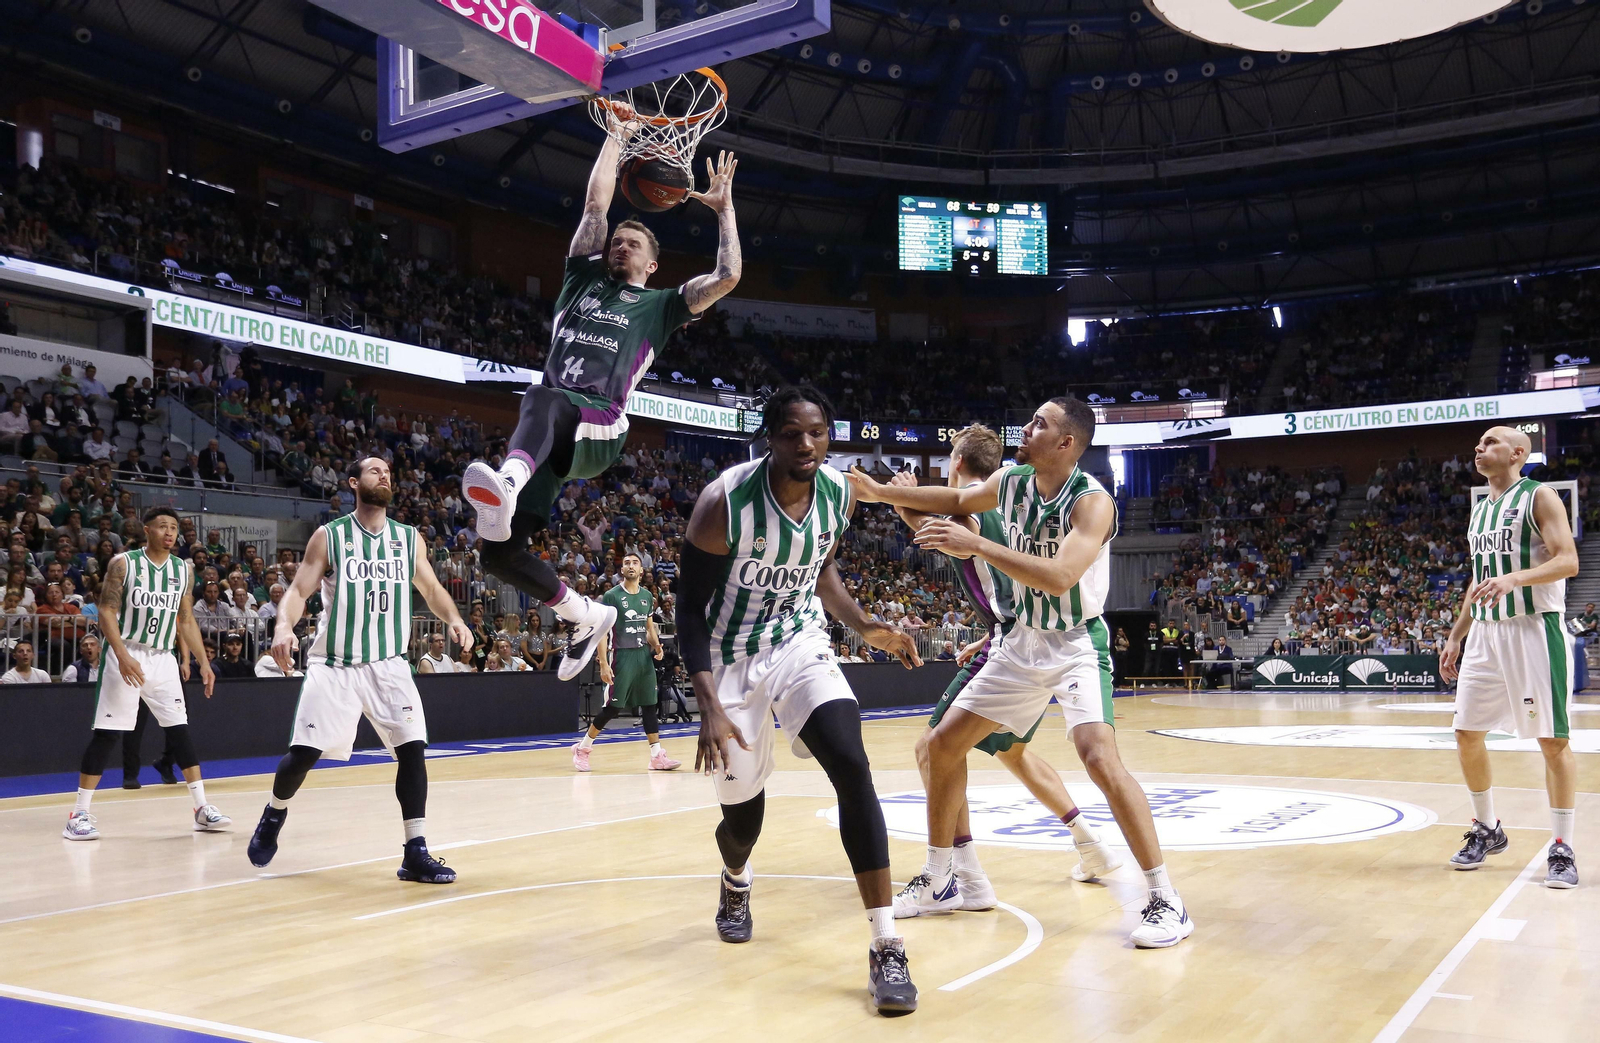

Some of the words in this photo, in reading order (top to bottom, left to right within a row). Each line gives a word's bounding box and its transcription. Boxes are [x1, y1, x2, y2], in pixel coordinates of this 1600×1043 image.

[946, 201, 960, 212] 68
[986, 203, 1000, 214] 59
[963, 250, 971, 261] 5
[982, 251, 990, 261] 5
[156, 296, 274, 342] CÉNT/LITRO
[280, 326, 305, 349] EN
[310, 332, 360, 360] CADA
[364, 344, 389, 365] REI
[577, 331, 618, 350] MÁLAGA
[41, 351, 54, 361] de
[56, 354, 94, 370] Málaga
[561, 355, 585, 382] 14
[667, 402, 683, 419] EN
[685, 406, 717, 426] CADA
[1284, 413, 1297, 435] 3
[1303, 410, 1393, 431] CÉNT/LITRO
[1397, 408, 1418, 423] EN
[1424, 404, 1469, 421] CADA
[1474, 401, 1499, 417] REI
[861, 425, 879, 440] 68
[240, 526, 269, 538] Málaga
[367, 590, 389, 613] 10
[762, 596, 797, 624] 15
[147, 617, 159, 635] 8
[1292, 671, 1340, 685] Unicaja
[1385, 671, 1435, 685] Unicaja
[1150, 805, 1221, 819] LAS
